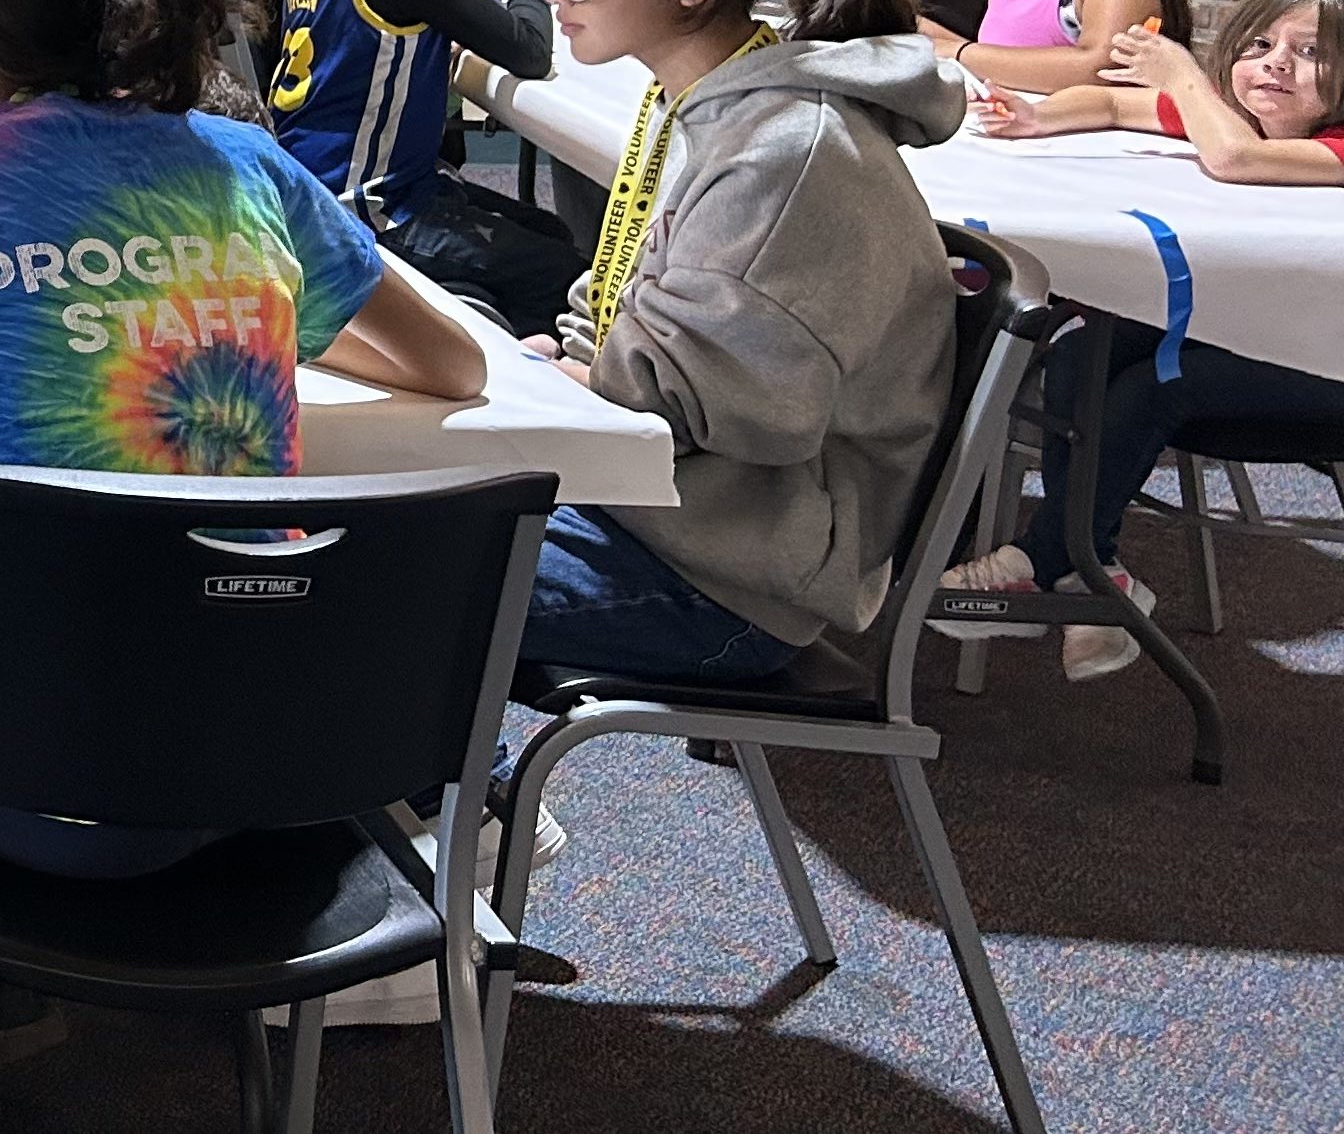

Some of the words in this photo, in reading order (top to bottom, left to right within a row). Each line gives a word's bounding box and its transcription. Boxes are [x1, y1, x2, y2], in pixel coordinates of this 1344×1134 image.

[622, 90, 655, 176] VOLUNTEER
[640, 109, 677, 195] VOLUNTEER
[593, 199, 627, 283] VOLUNTEER
[607, 217, 645, 301] VOLUNTEER
[62, 296, 262, 353] STAFF
[216, 580, 298, 593] LIFETIME
